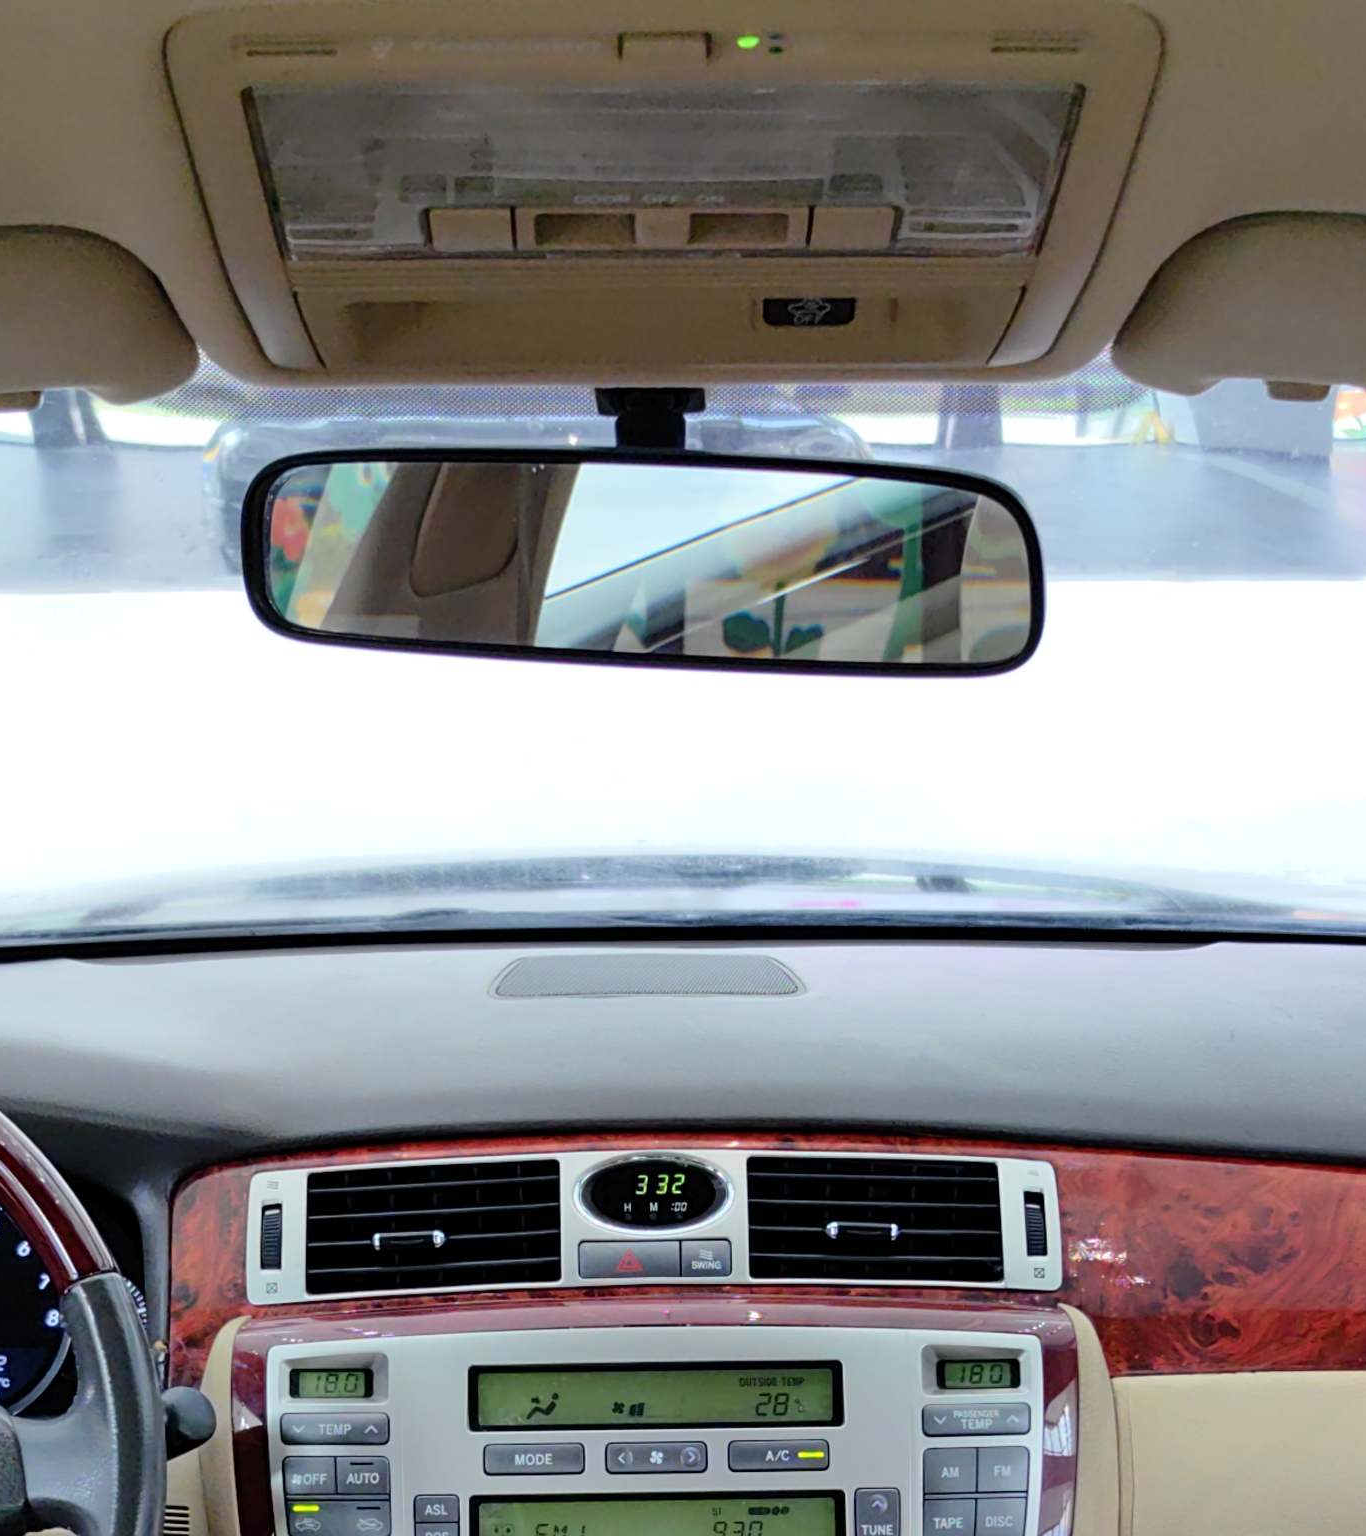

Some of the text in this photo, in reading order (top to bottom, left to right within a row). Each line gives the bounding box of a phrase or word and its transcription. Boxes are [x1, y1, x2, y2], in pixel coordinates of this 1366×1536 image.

[16, 1240, 31, 1257] 6
[691, 1261, 722, 1270] SWING
[38, 1272, 50, 1291] 7
[45, 1309, 60, 1327] 8
[953, 1410, 1000, 1418] PASSENGER
[318, 1424, 352, 1435] TEMP
[960, 1418, 993, 1431] TEMP
[514, 1454, 553, 1466] MODE
[765, 1450, 790, 1462] A/C
[941, 1466, 960, 1479] AM
[993, 1464, 1012, 1477] FM
[303, 1473, 328, 1485] OFF
[346, 1473, 380, 1485] AUTO
[424, 1504, 448, 1516] ASL
[933, 1517, 964, 1529] TAPE
[985, 1515, 1014, 1528] DISC
[861, 1524, 894, 1536] TUNE
